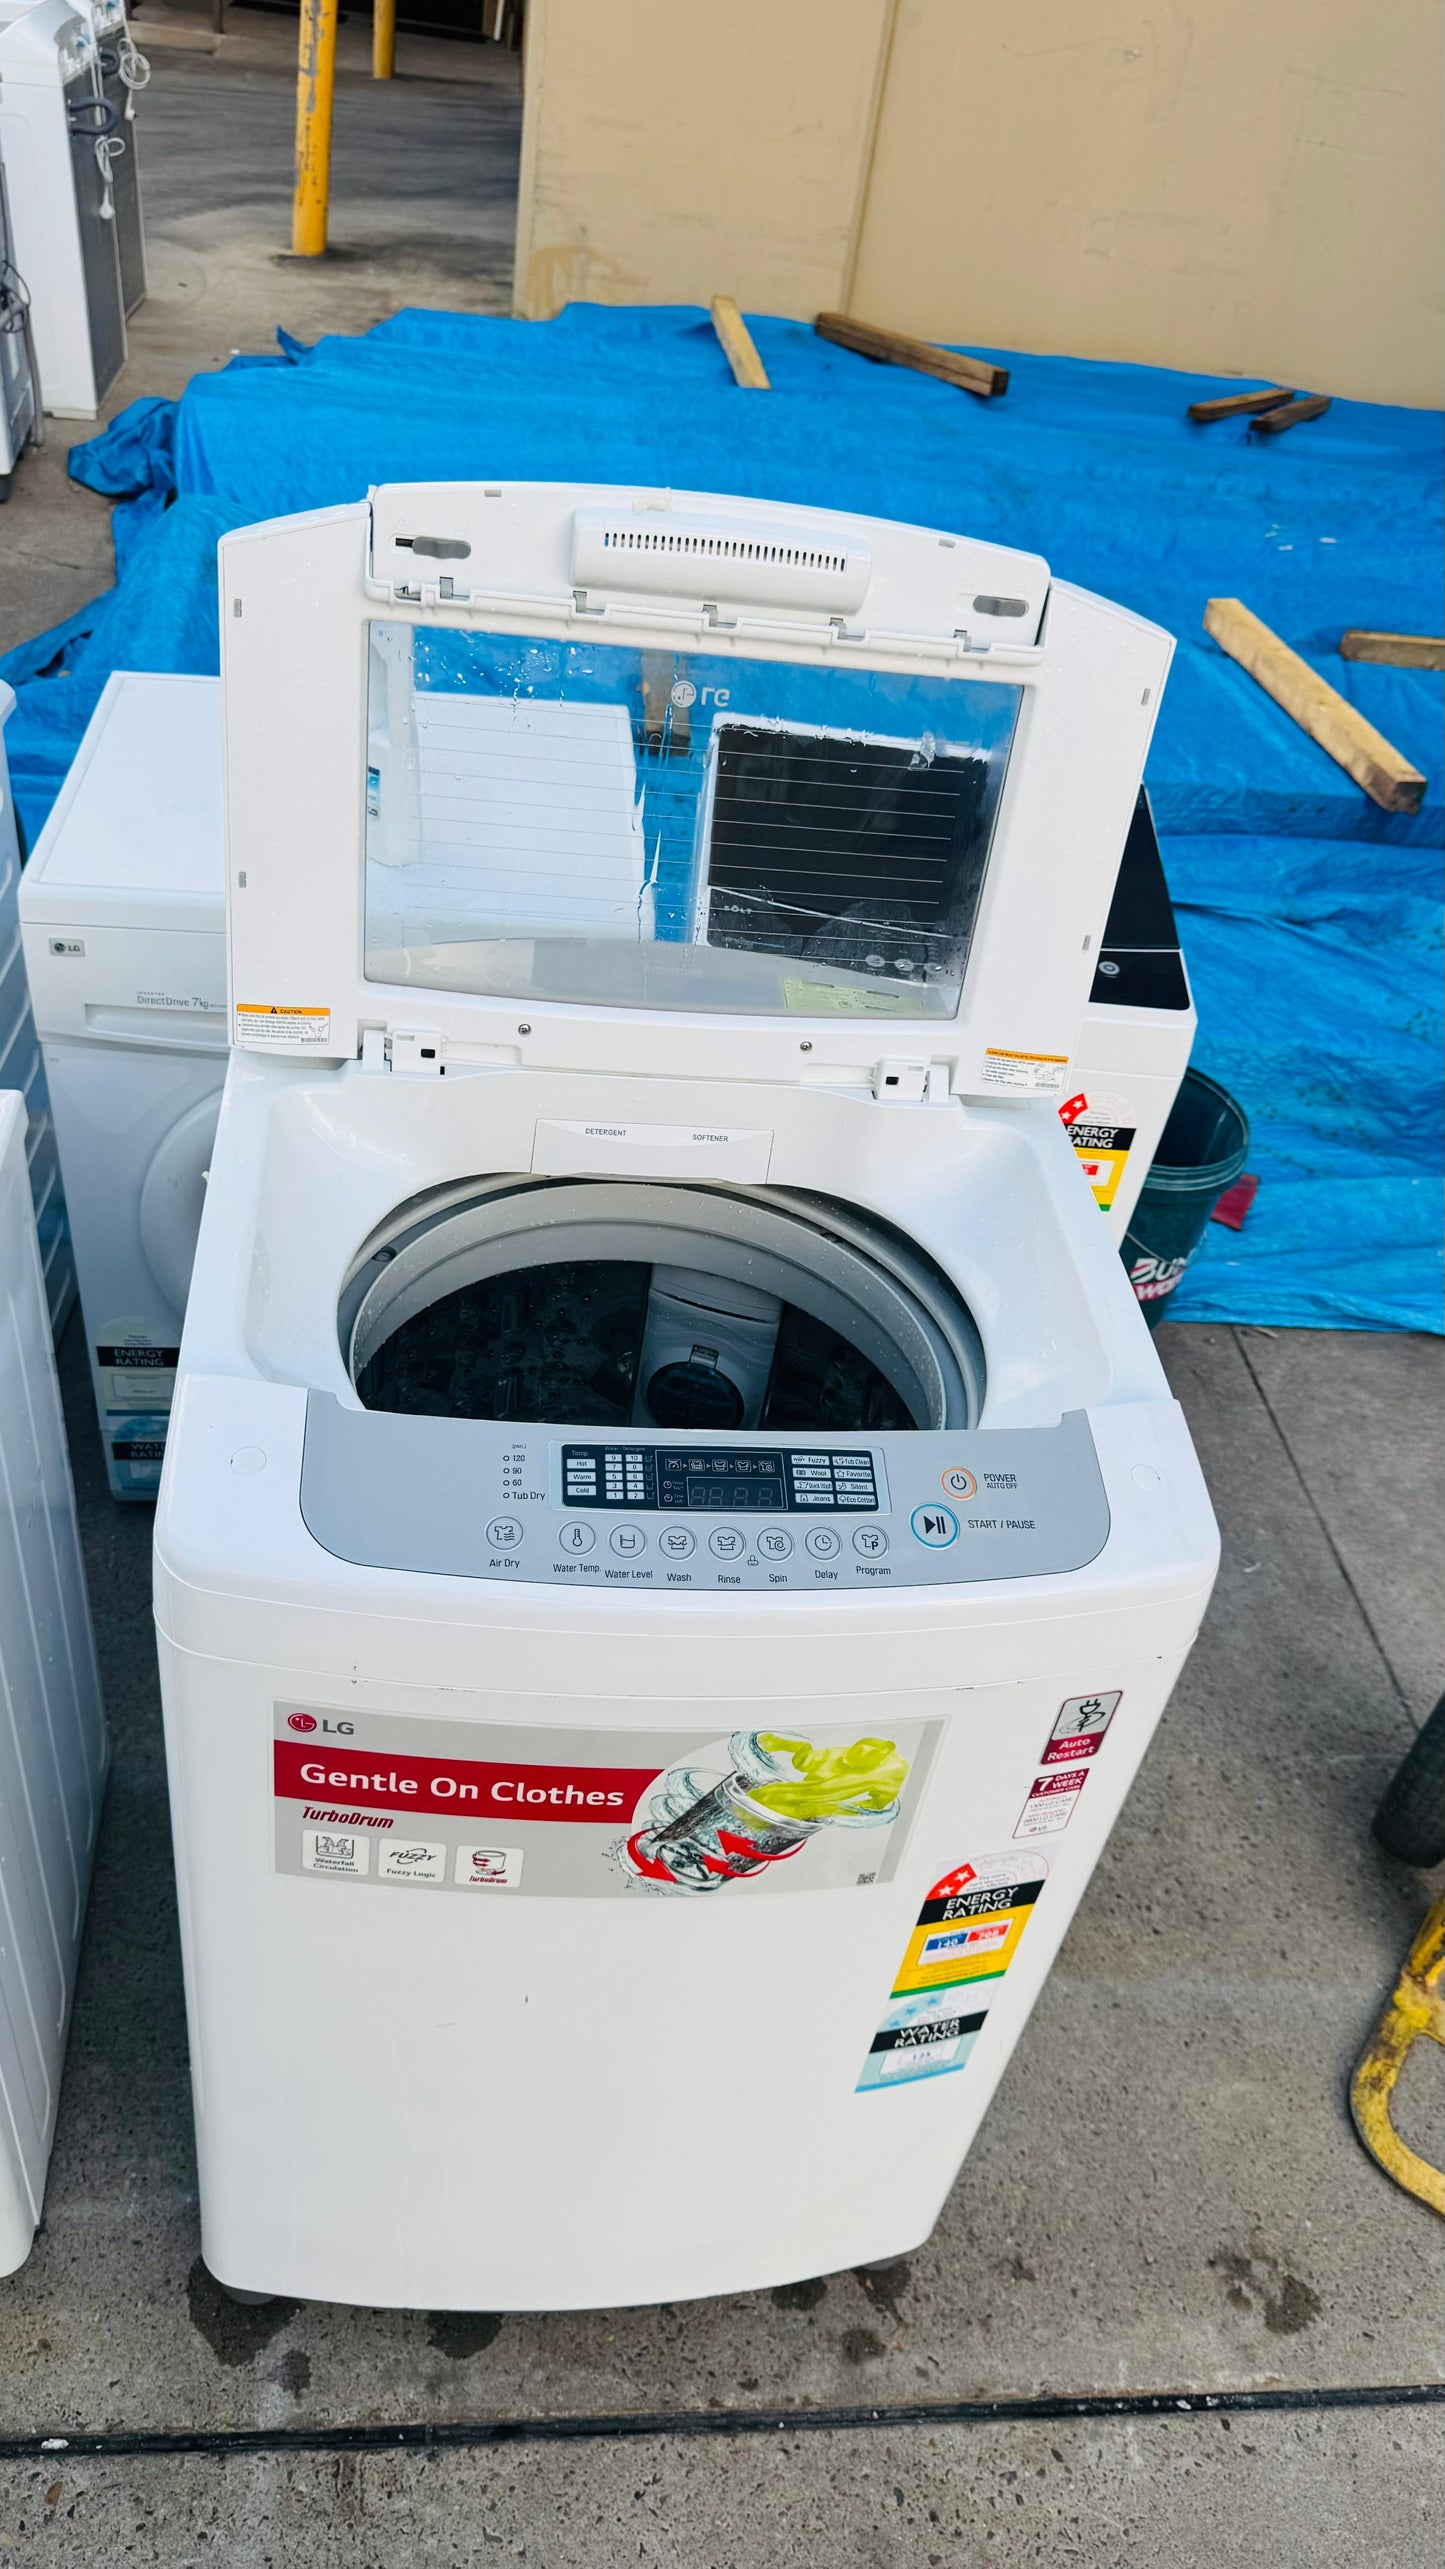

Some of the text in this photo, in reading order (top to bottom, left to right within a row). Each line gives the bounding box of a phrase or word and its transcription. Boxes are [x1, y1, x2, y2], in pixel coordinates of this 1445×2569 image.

[585, 1128, 626, 1136] DETERGENT
[1066, 1125, 1119, 1138] ENERGY
[692, 1134, 728, 1142] SOFTENER
[1070, 1136, 1114, 1148] ATING
[114, 1349, 164, 1358] ENERGY
[116, 1358, 164, 1366] RATING
[984, 1474, 1017, 1482] POWER
[530, 1492, 546, 1501] Dry
[968, 1520, 997, 1528] START
[1007, 1520, 1036, 1529] PAUSE
[489, 1558, 520, 1569] Air Dry
[553, 1564, 576, 1572] Water
[605, 1570, 653, 1579] Water Level
[815, 1570, 838, 1580] Delay
[856, 1566, 891, 1576] Program
[667, 1572, 692, 1581] Wash
[718, 1575, 741, 1584] Rinse
[769, 1574, 788, 1583] Spin
[322, 1718, 355, 1736] LG
[1059, 1738, 1091, 1750] Auto
[1047, 1746, 1096, 1761] Restart
[300, 1763, 624, 1806] Gentle On Clothes
[1038, 1777, 1054, 1791] 7
[1055, 1772, 1077, 1781] DAYS
[1052, 1777, 1083, 1788] WEEK
[302, 1806, 394, 1829] TurboDrum
[390, 1850, 438, 1862] FUZZY
[314, 1857, 354, 1867] Waterfall
[313, 1862, 359, 1873] Circulation
[386, 1868, 436, 1878] Fuzzy Logic
[469, 1876, 508, 1884] TurboDrum
[945, 1886, 1019, 1910] ENERGY
[942, 1898, 1012, 1921] RATING
[900, 2018, 960, 2038] WATER
[894, 2030, 959, 2048] RATING
